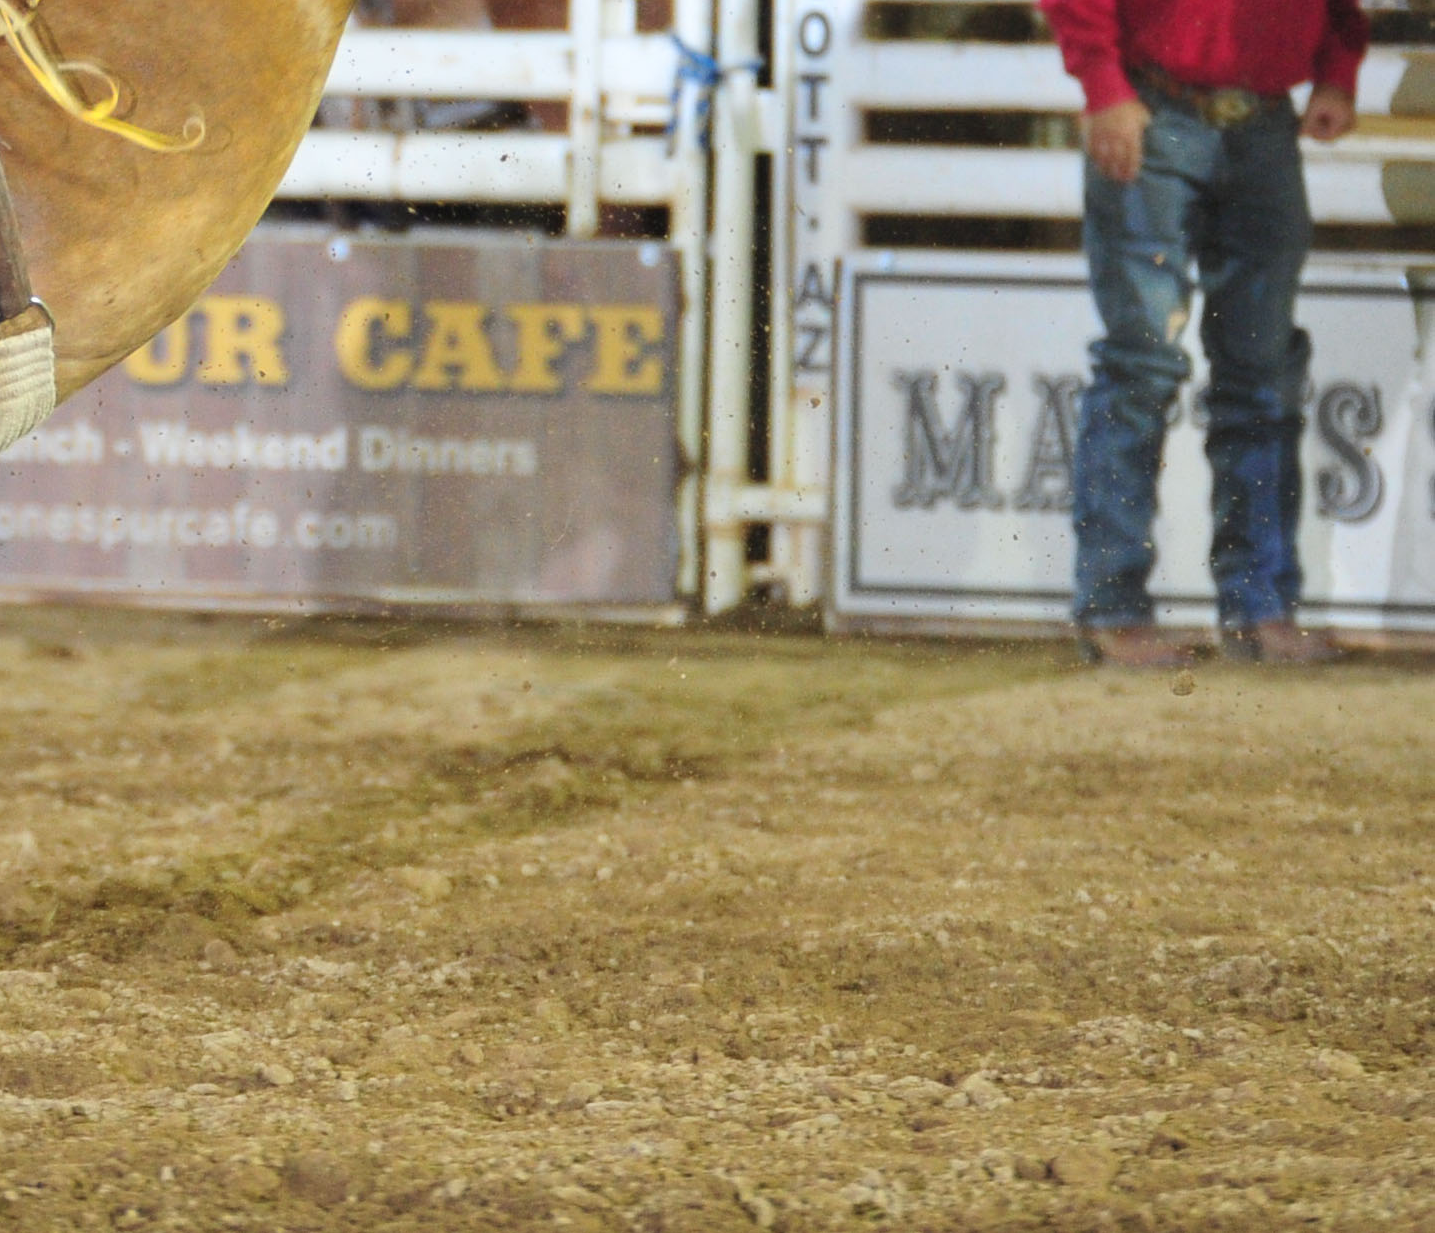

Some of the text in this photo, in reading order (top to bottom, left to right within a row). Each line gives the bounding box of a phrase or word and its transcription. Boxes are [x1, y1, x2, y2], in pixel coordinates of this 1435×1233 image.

[123, 293, 665, 395] UR CAFE
[140, 420, 349, 470] Weekend
[359, 425, 538, 476] Dinners
[890, 369, 1384, 523] MAS
